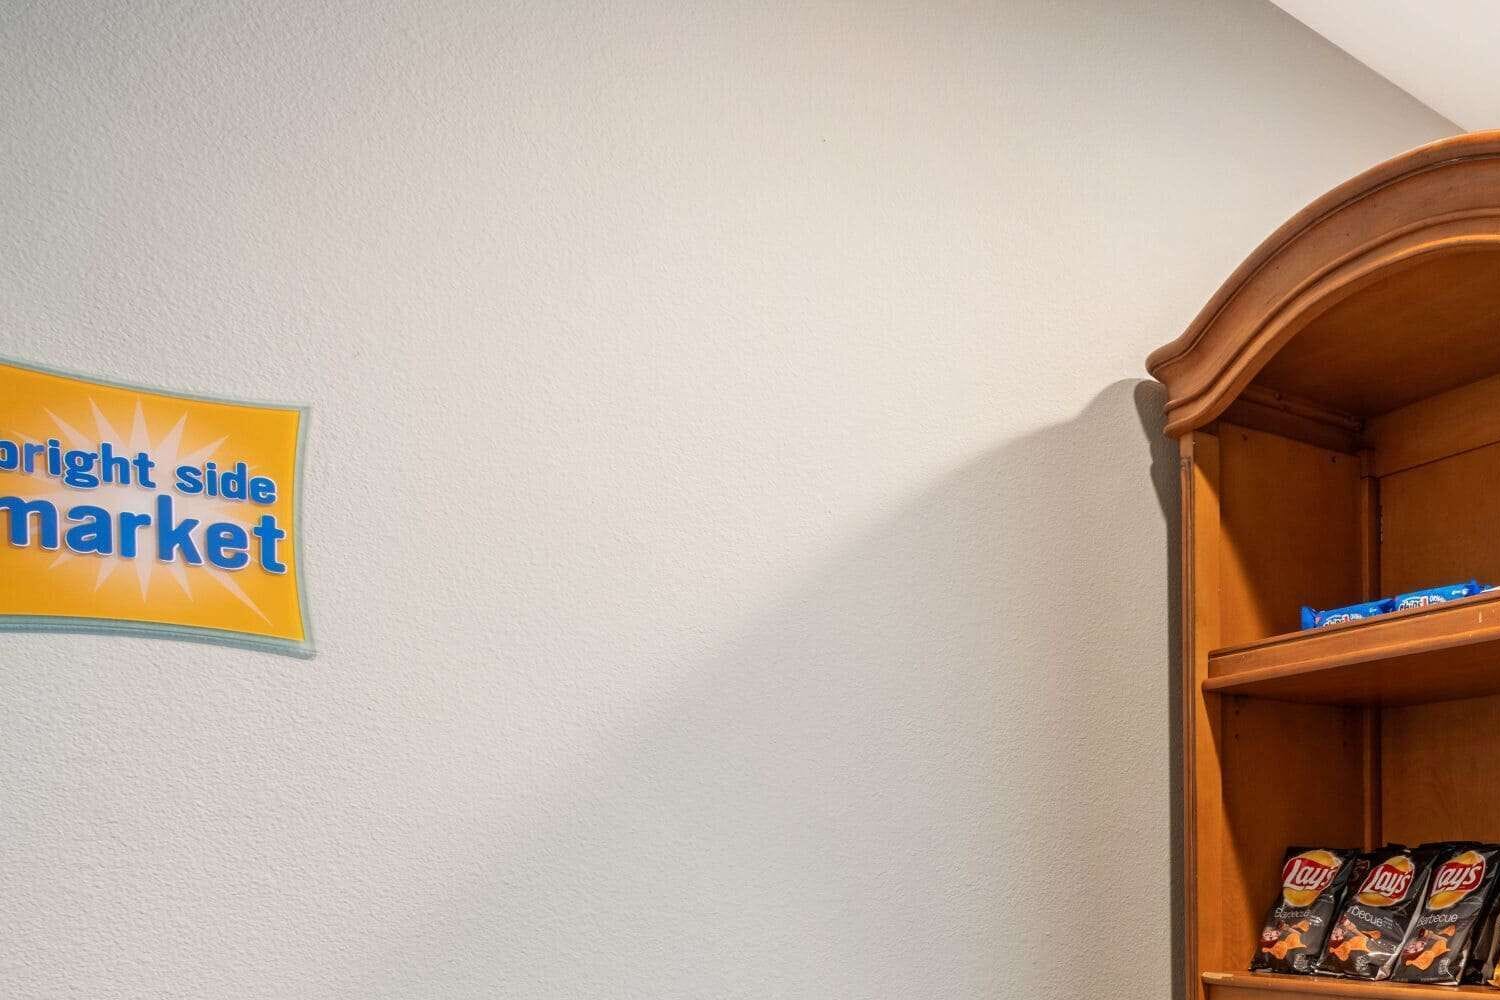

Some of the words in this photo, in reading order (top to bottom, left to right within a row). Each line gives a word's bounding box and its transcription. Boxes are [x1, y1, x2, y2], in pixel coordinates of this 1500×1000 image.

[175, 461, 277, 506] side
[0, 494, 288, 575] market
[1360, 866, 1411, 899] Lay's
[1433, 860, 1484, 891] Lay's
